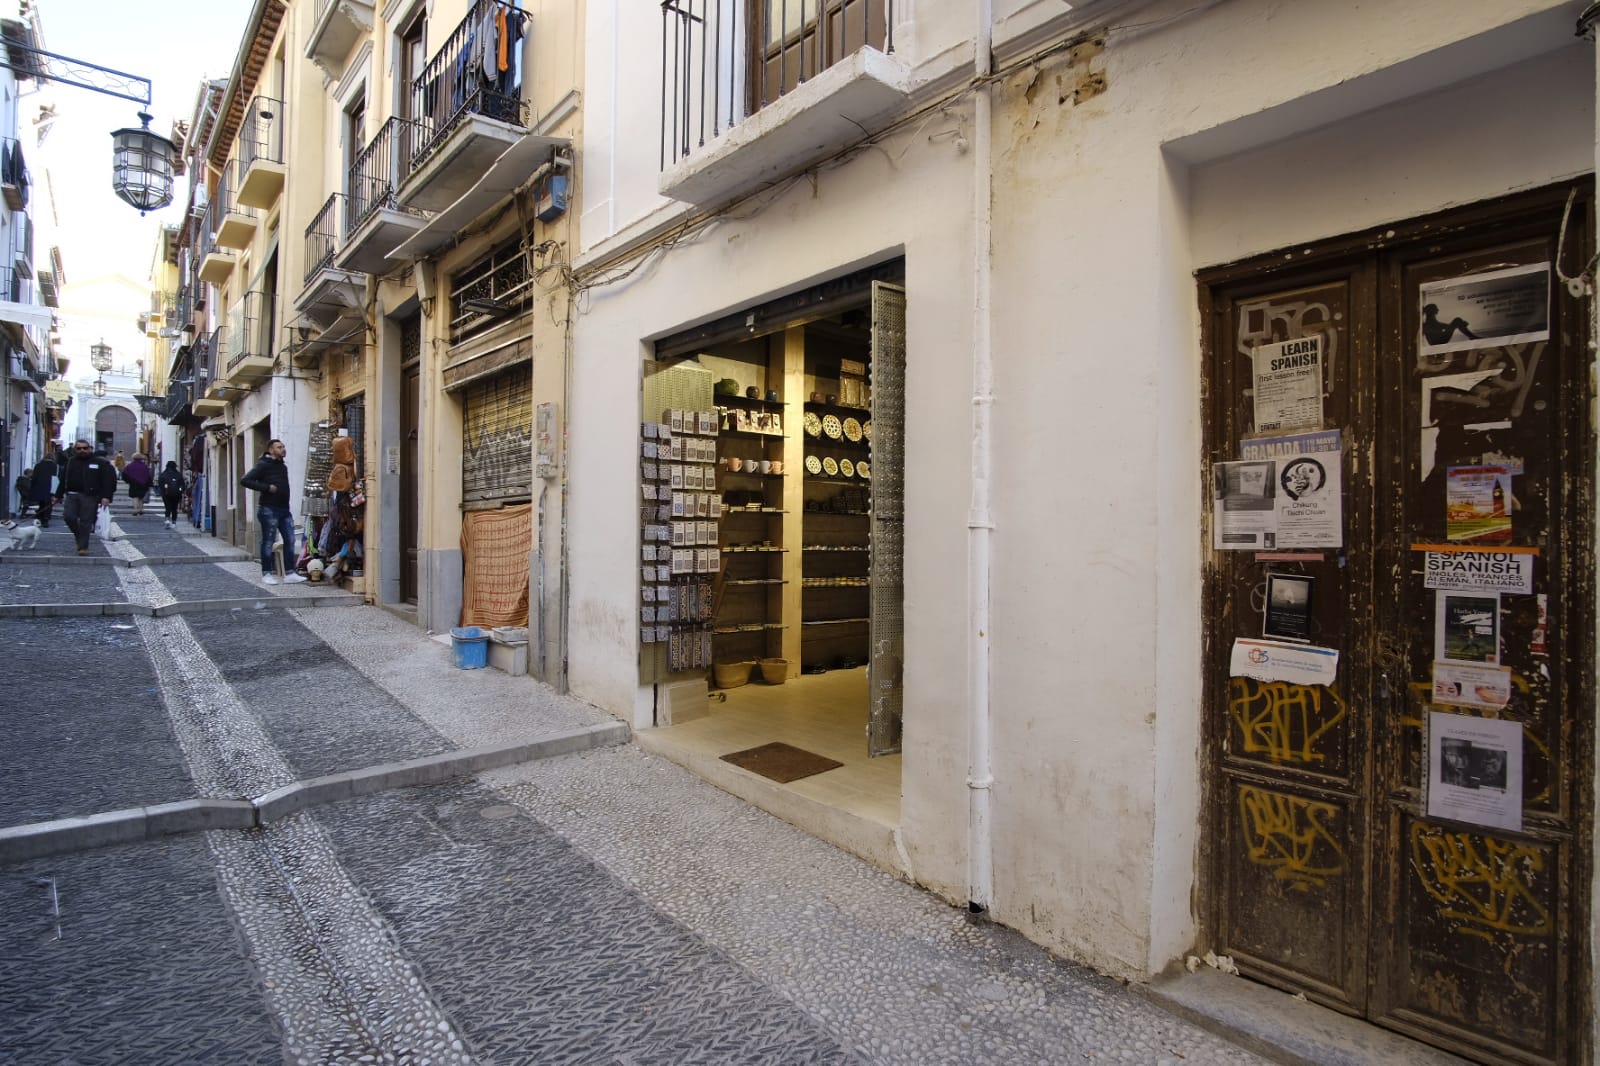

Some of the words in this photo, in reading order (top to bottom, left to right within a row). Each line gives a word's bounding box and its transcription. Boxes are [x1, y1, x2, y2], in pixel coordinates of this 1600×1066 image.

[1282, 340, 1318, 357] LEARN
[1271, 353, 1318, 371] SPANISH
[1243, 440, 1301, 460] GRANADA
[1428, 560, 1521, 574] SPANISH
